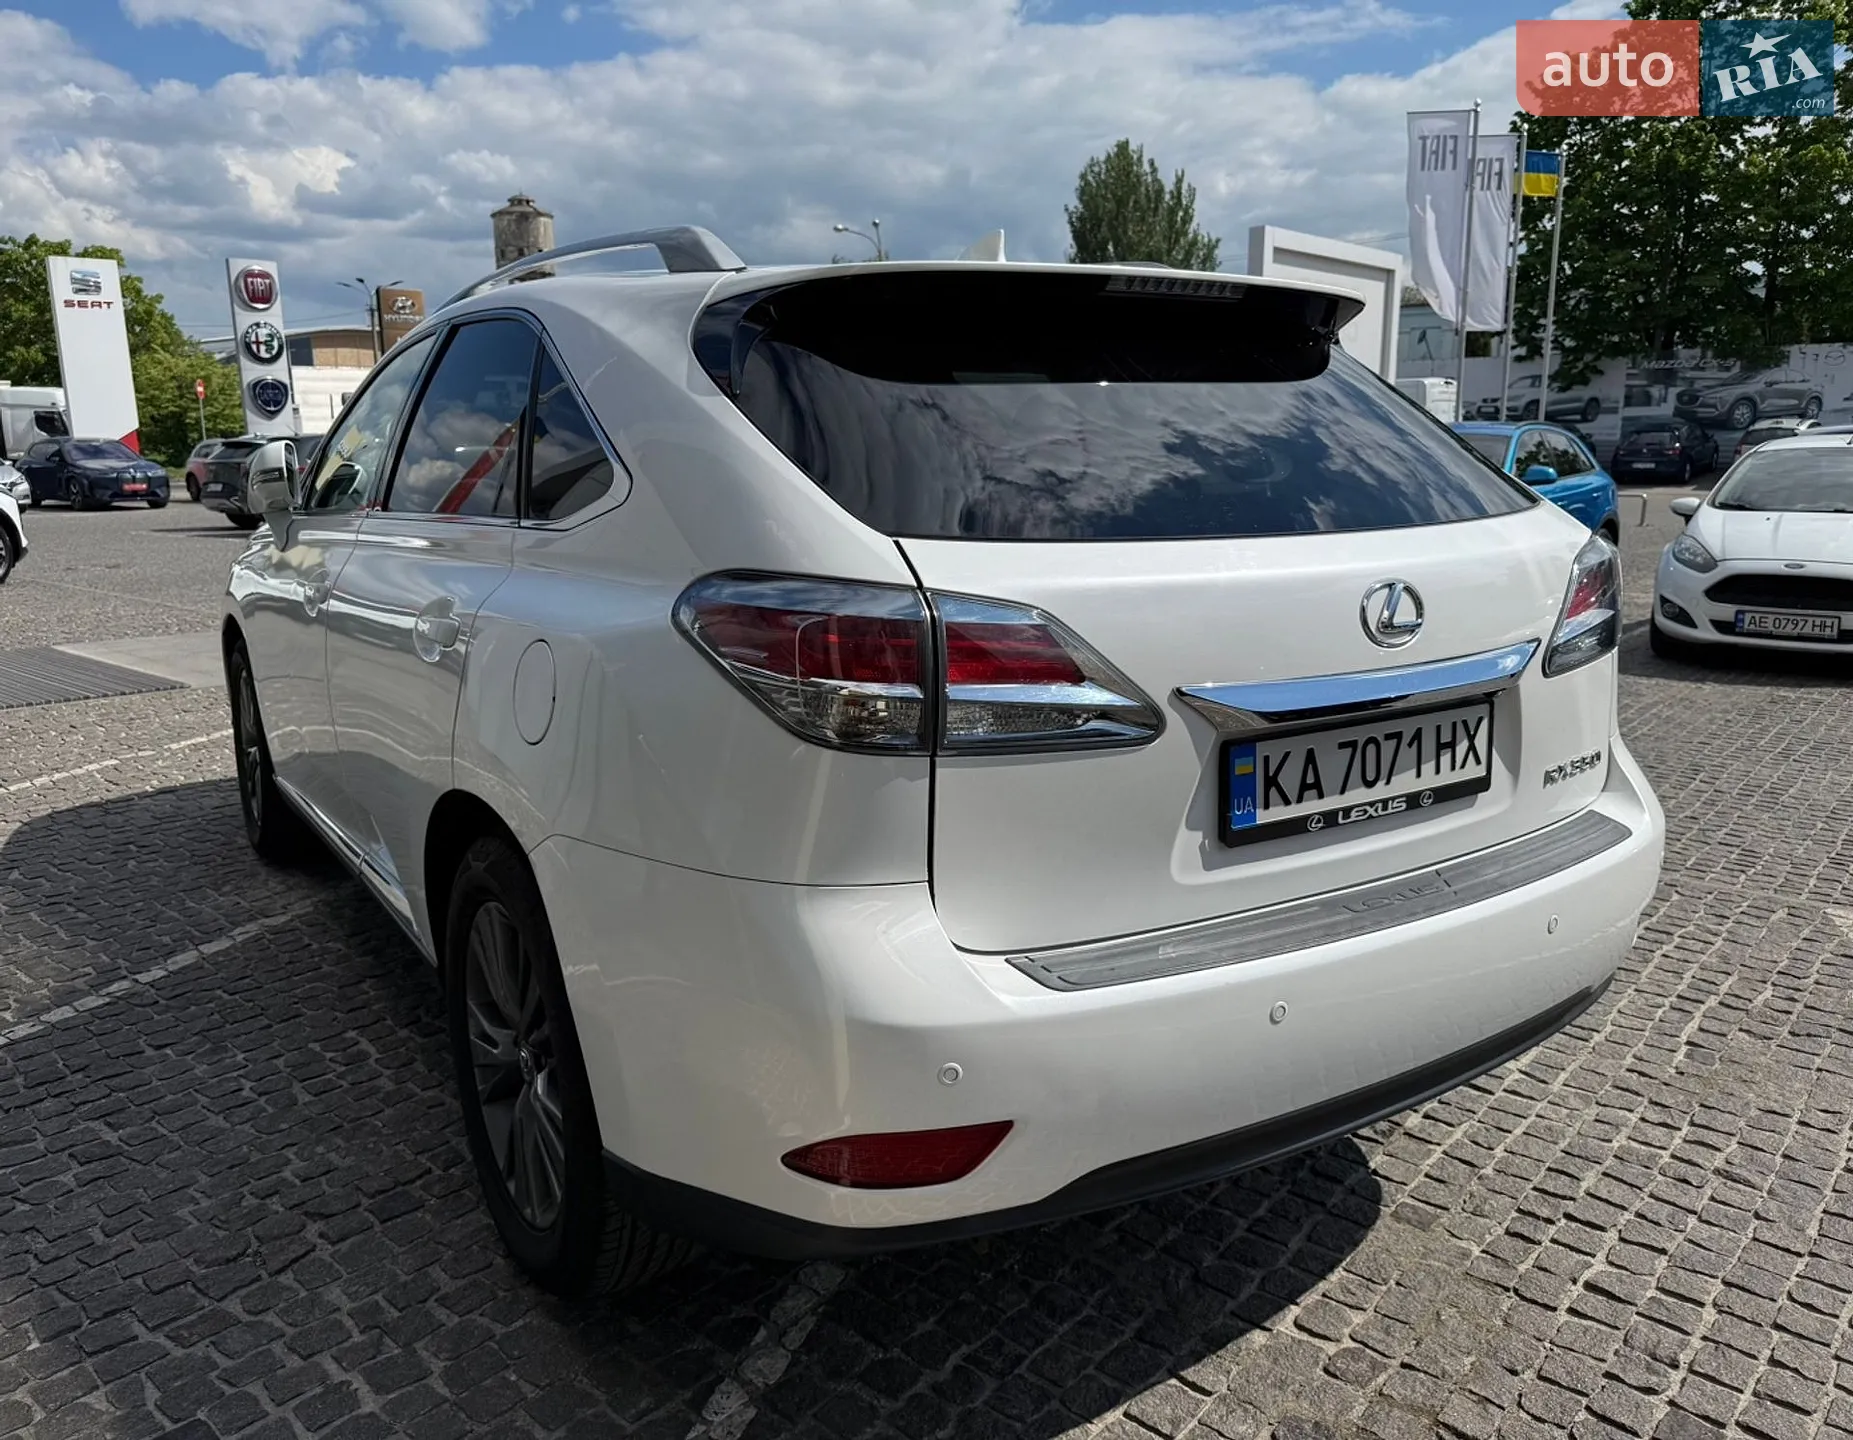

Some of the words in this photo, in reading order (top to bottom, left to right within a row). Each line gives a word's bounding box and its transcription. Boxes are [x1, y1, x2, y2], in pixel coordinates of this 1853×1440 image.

[247, 277, 271, 297] FIAT
[63, 299, 114, 309] SEAT
[1747, 616, 1769, 629] AE
[1772, 617, 1809, 632] 0797
[1811, 620, 1835, 633] HH
[1263, 746, 1325, 811] KA
[1337, 726, 1423, 796] 7071
[1434, 716, 1485, 776] HX
[1233, 796, 1254, 815] UA
[1337, 797, 1407, 825] LEXUS
